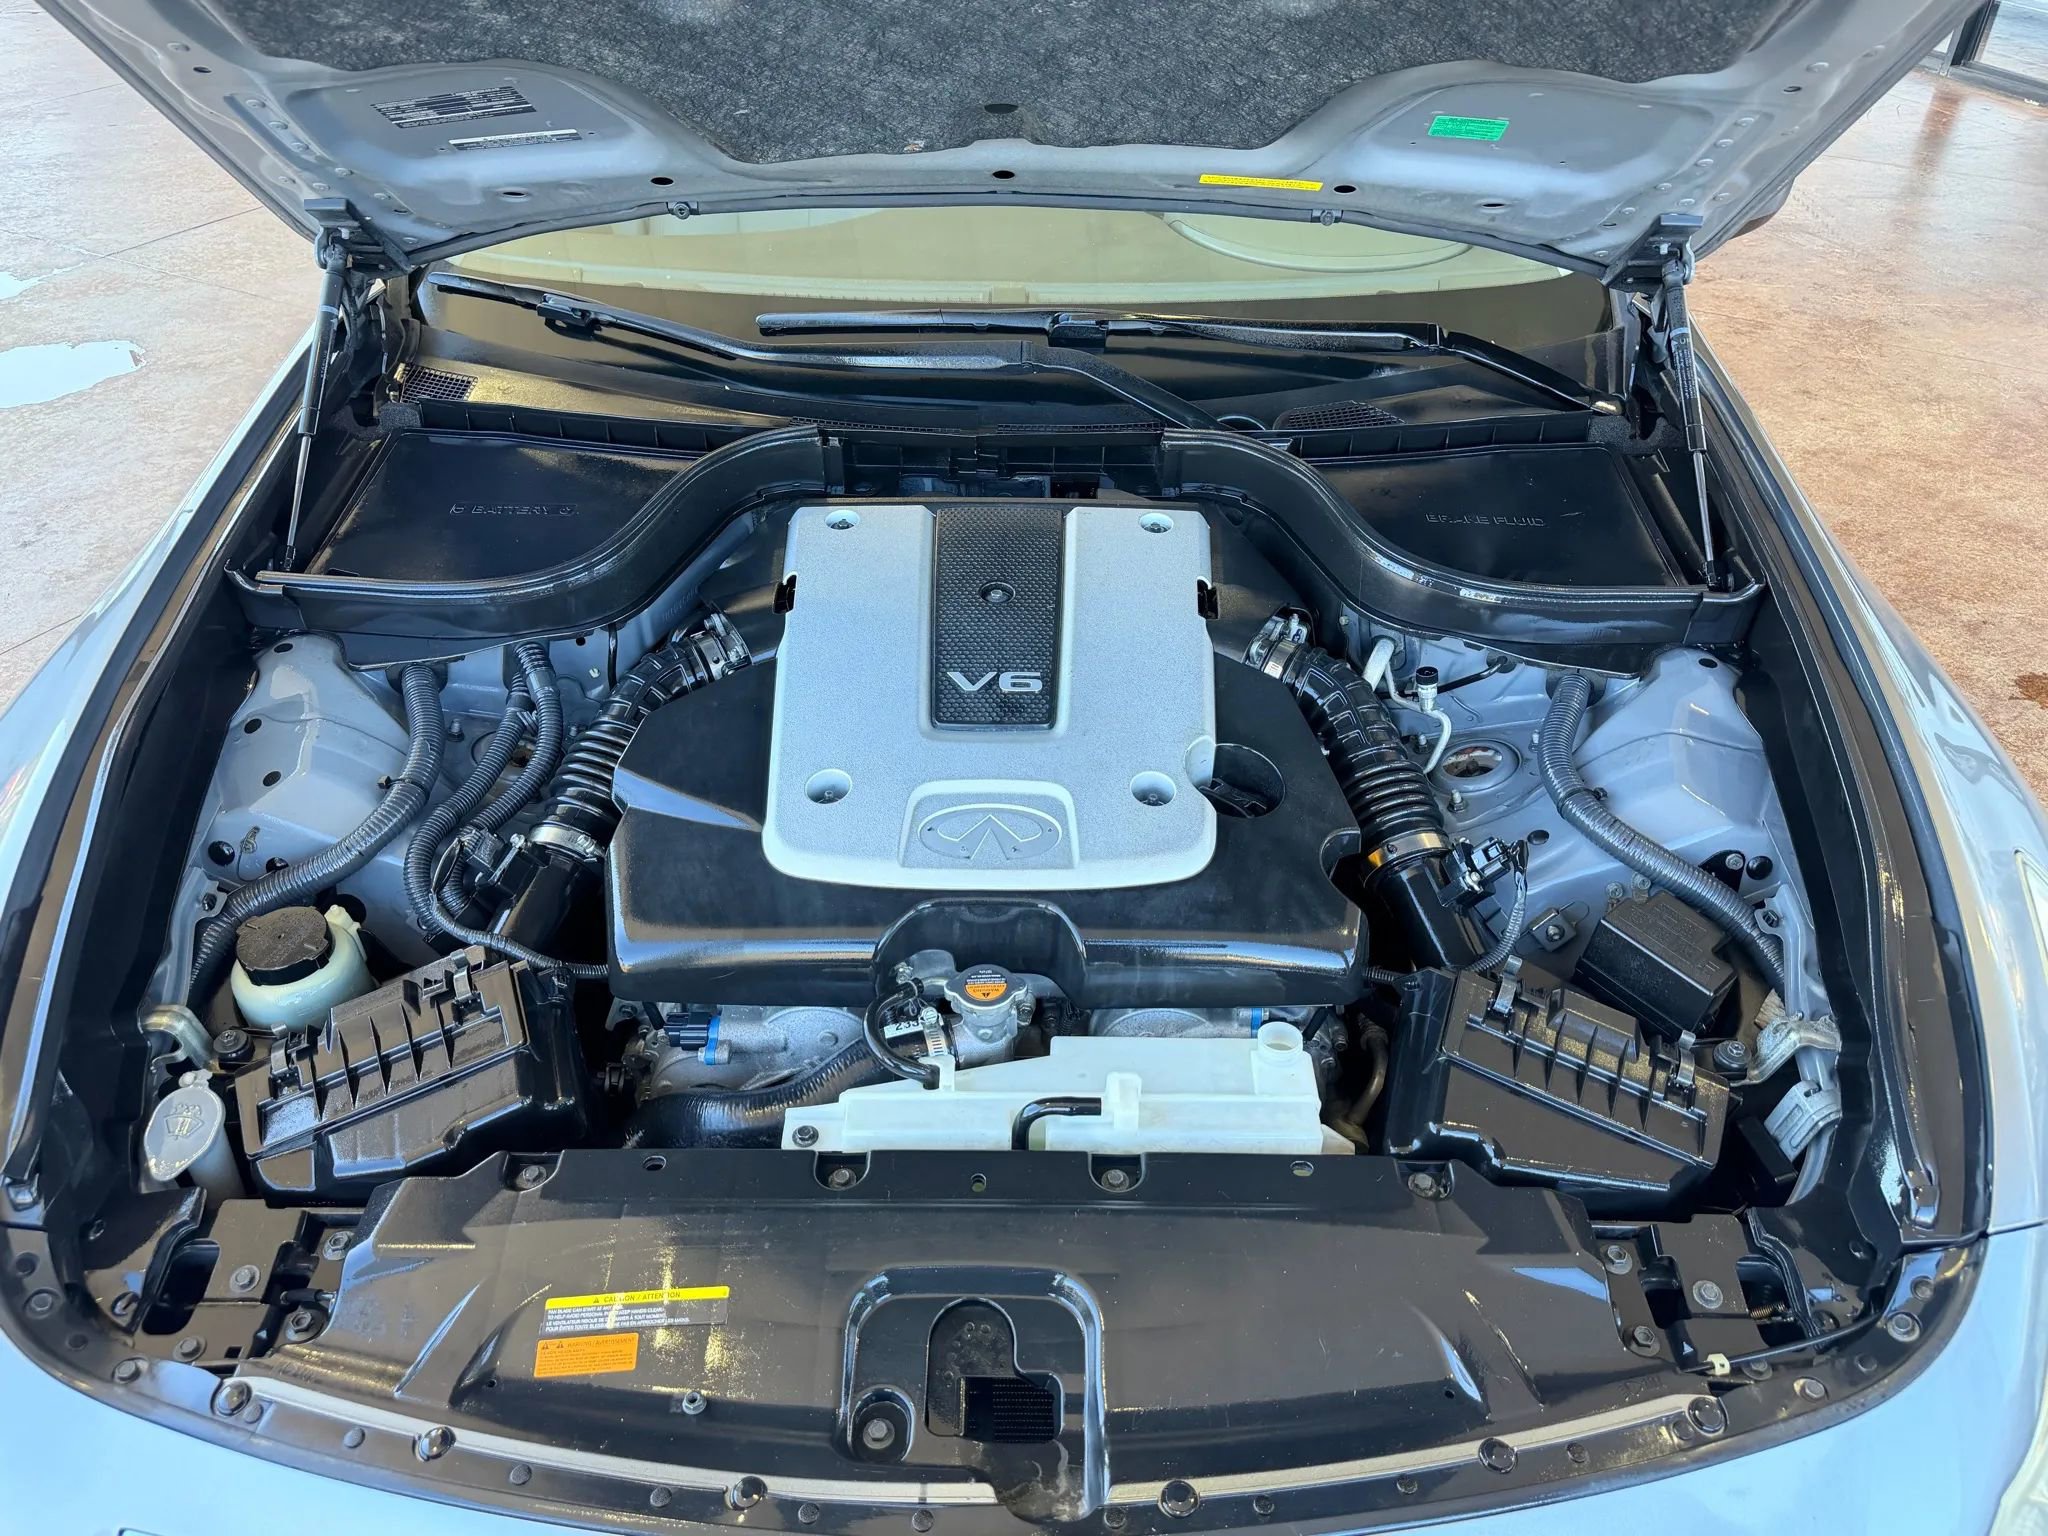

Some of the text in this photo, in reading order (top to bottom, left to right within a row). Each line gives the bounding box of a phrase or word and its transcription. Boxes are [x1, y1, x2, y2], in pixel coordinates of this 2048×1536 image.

[1493, 516, 1546, 527] FLUID
[946, 671, 1042, 692] V6
[642, 1291, 681, 1300] ATTENION
